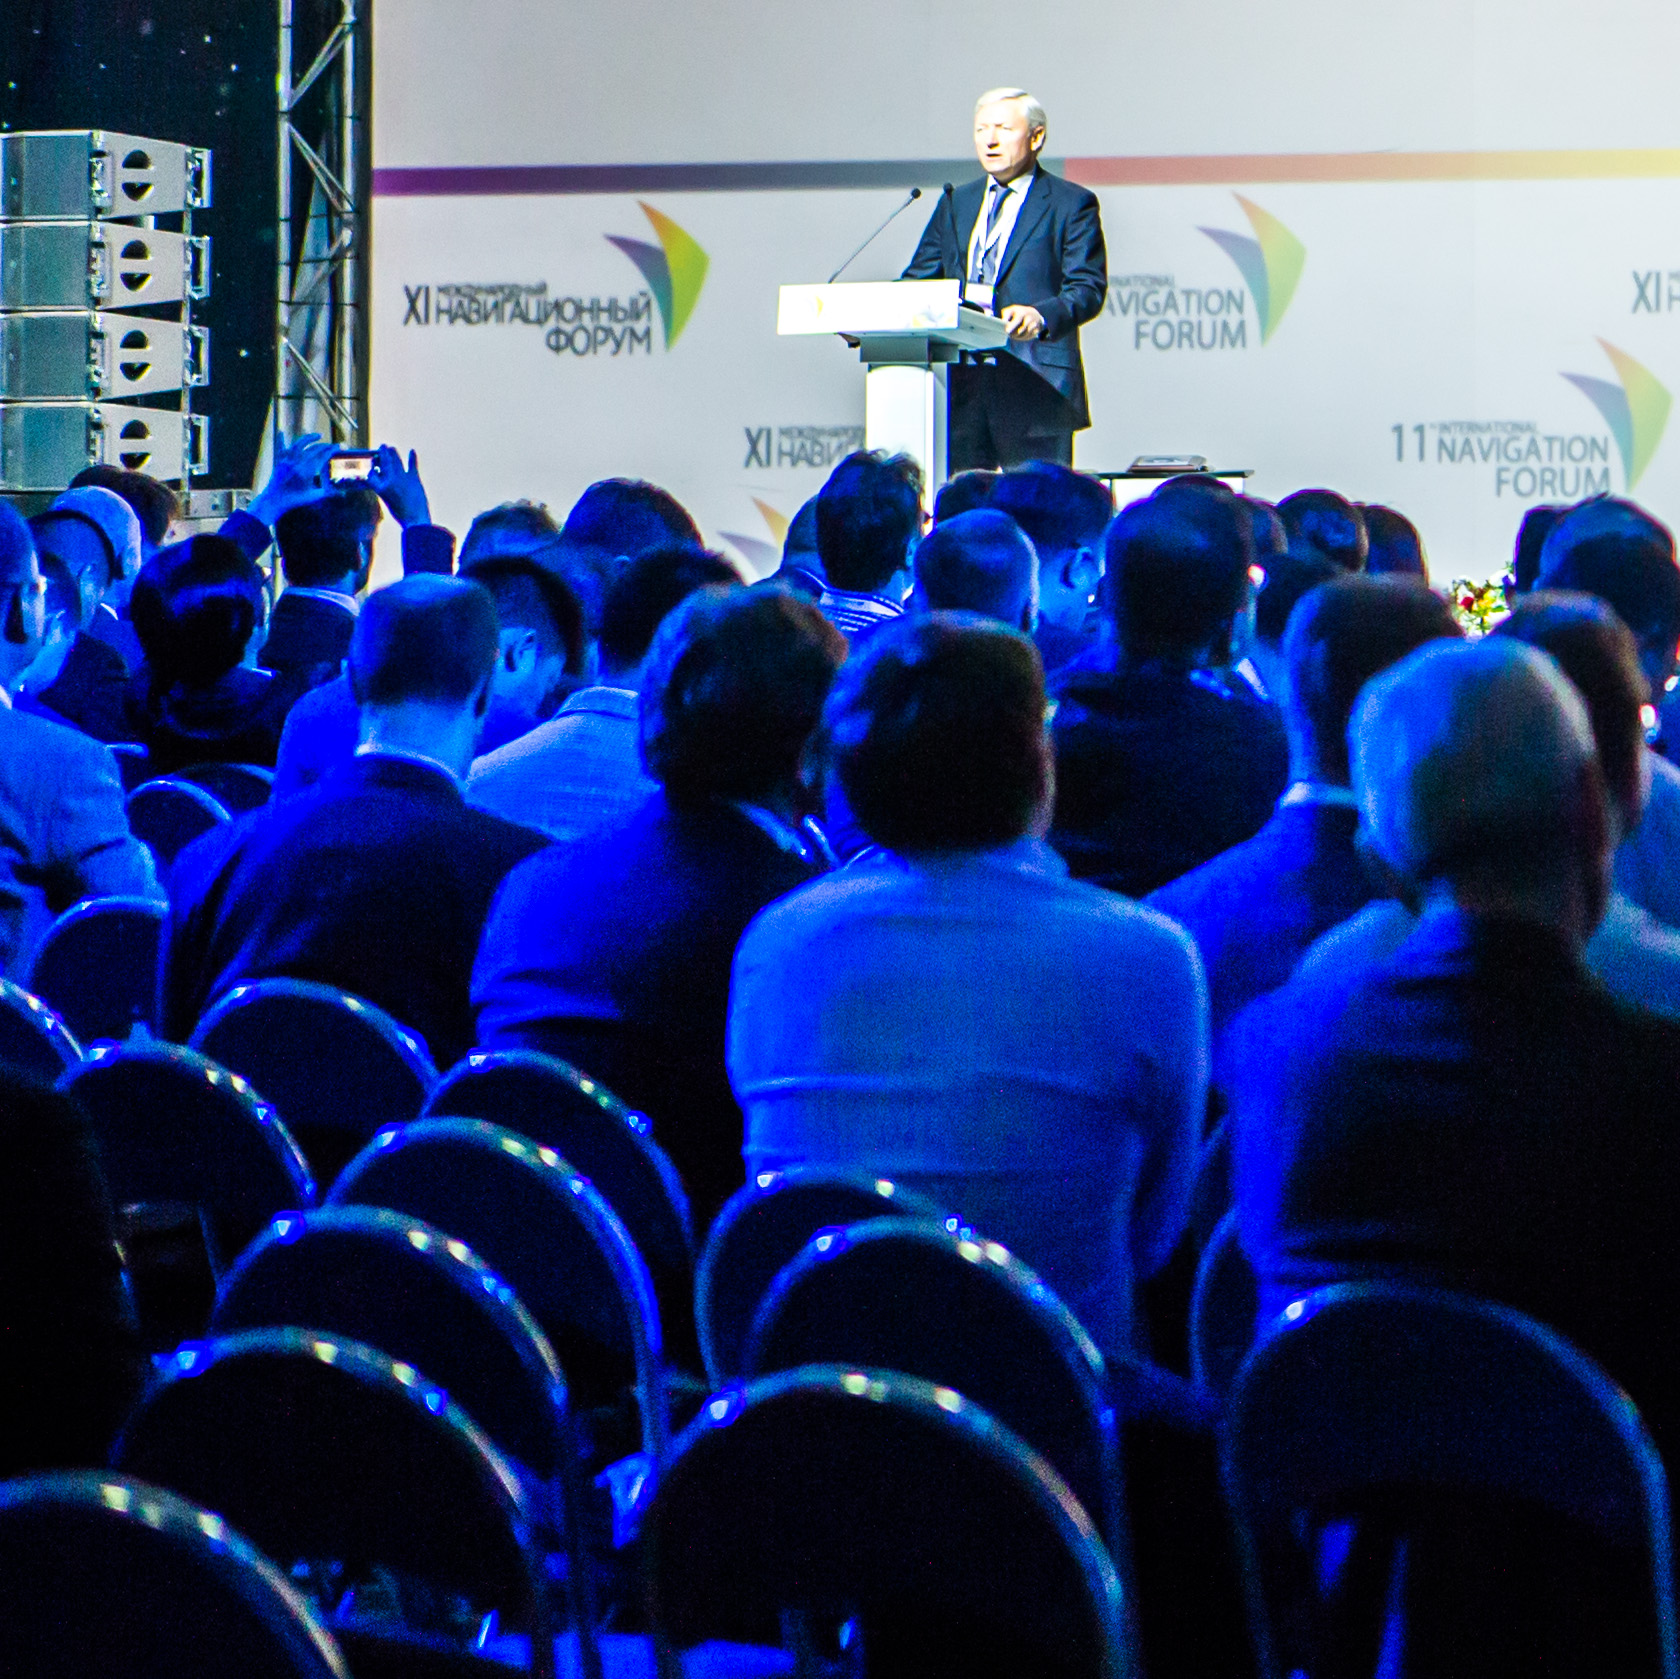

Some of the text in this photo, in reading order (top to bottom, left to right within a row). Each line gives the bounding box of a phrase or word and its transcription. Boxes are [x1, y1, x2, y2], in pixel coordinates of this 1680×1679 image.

[403, 284, 430, 327] XI
[1106, 287, 1245, 317] AVIGATION
[1631, 270, 1661, 314] XI
[545, 323, 652, 356] ФОРУМ
[1134, 319, 1247, 351] FORUM
[744, 426, 771, 469] XI
[1437, 434, 1609, 464] NAVIGATION
[1495, 465, 1611, 499] FORUM
